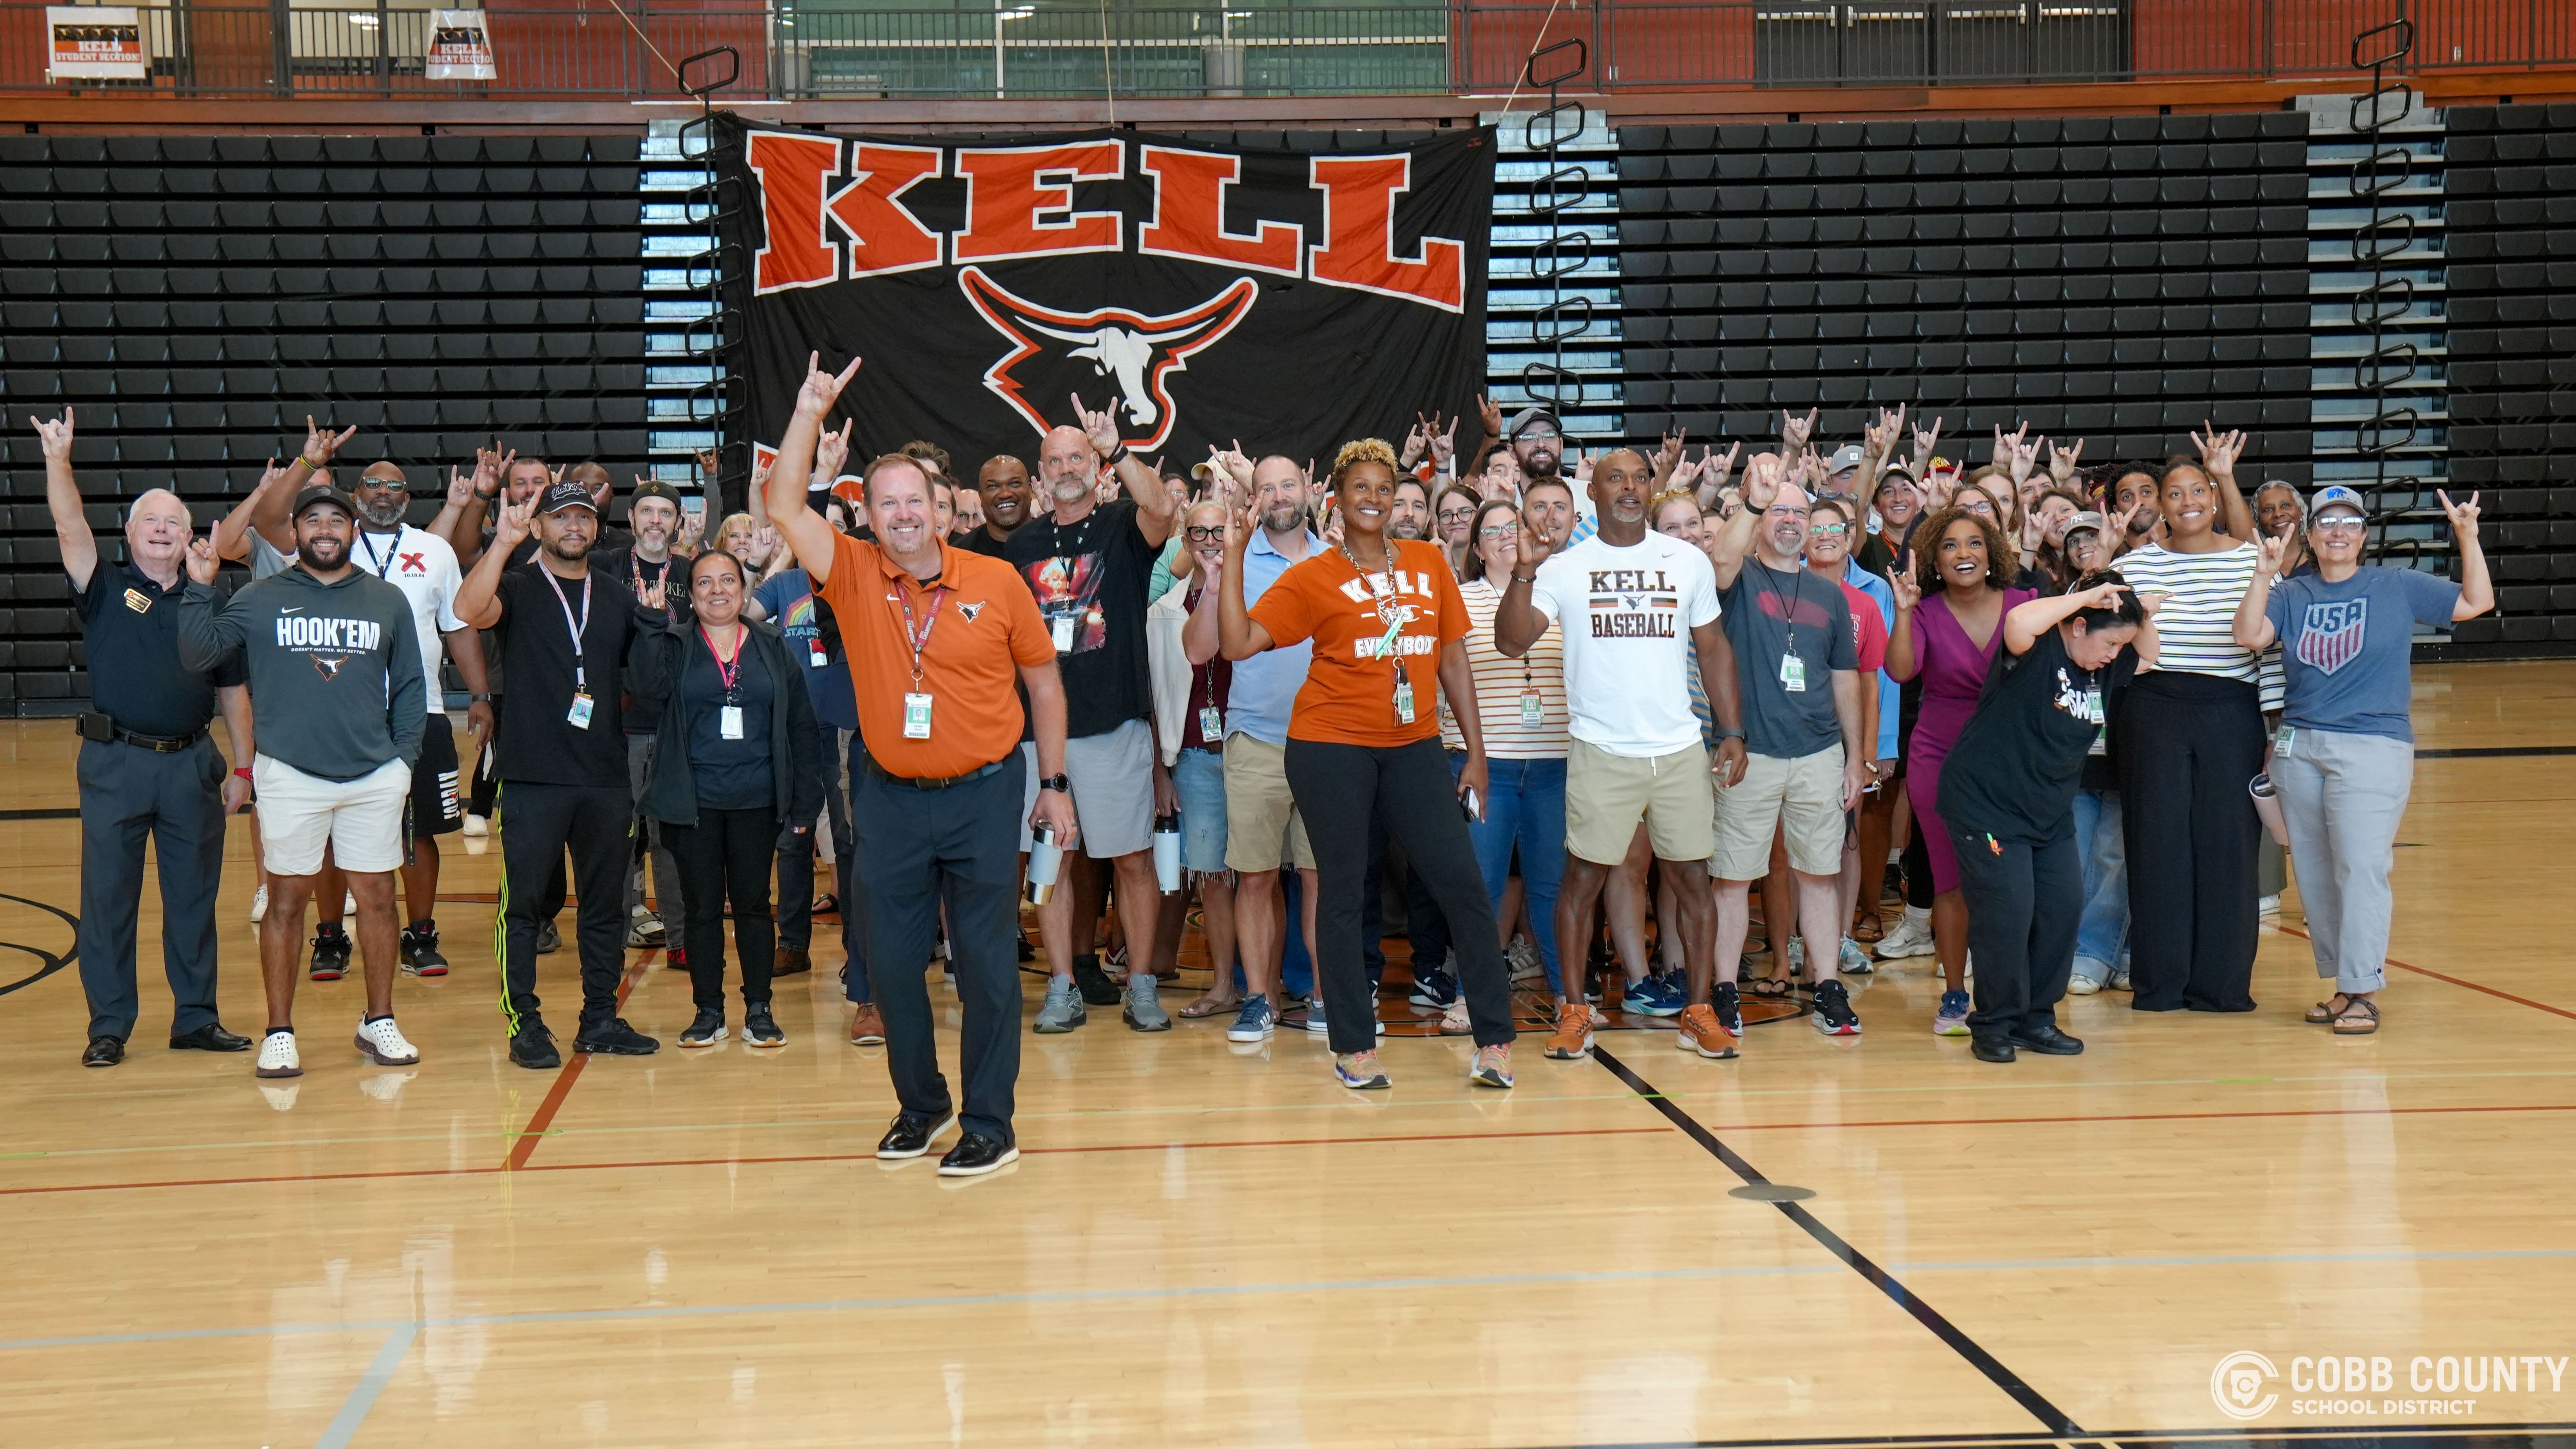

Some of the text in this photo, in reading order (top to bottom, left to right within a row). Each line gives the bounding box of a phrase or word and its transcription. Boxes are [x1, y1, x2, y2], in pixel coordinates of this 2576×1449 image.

[56, 52, 97, 61] STUDENT
[78, 41, 122, 52] KELL
[441, 44, 481, 54] KELL
[746, 130, 1465, 314] KELL
[1338, 570, 1433, 604] KELL
[1589, 570, 1676, 593] KELL
[922, 616, 935, 640] CHAMPIONS
[1591, 613, 1675, 639] BASEBALL
[1850, 613, 1860, 622] 021
[2308, 602, 2362, 633] USA
[276, 616, 381, 651] HOOK'EM
[906, 620, 916, 644] CHAMPIONS
[438, 769, 460, 820] JORDAN
